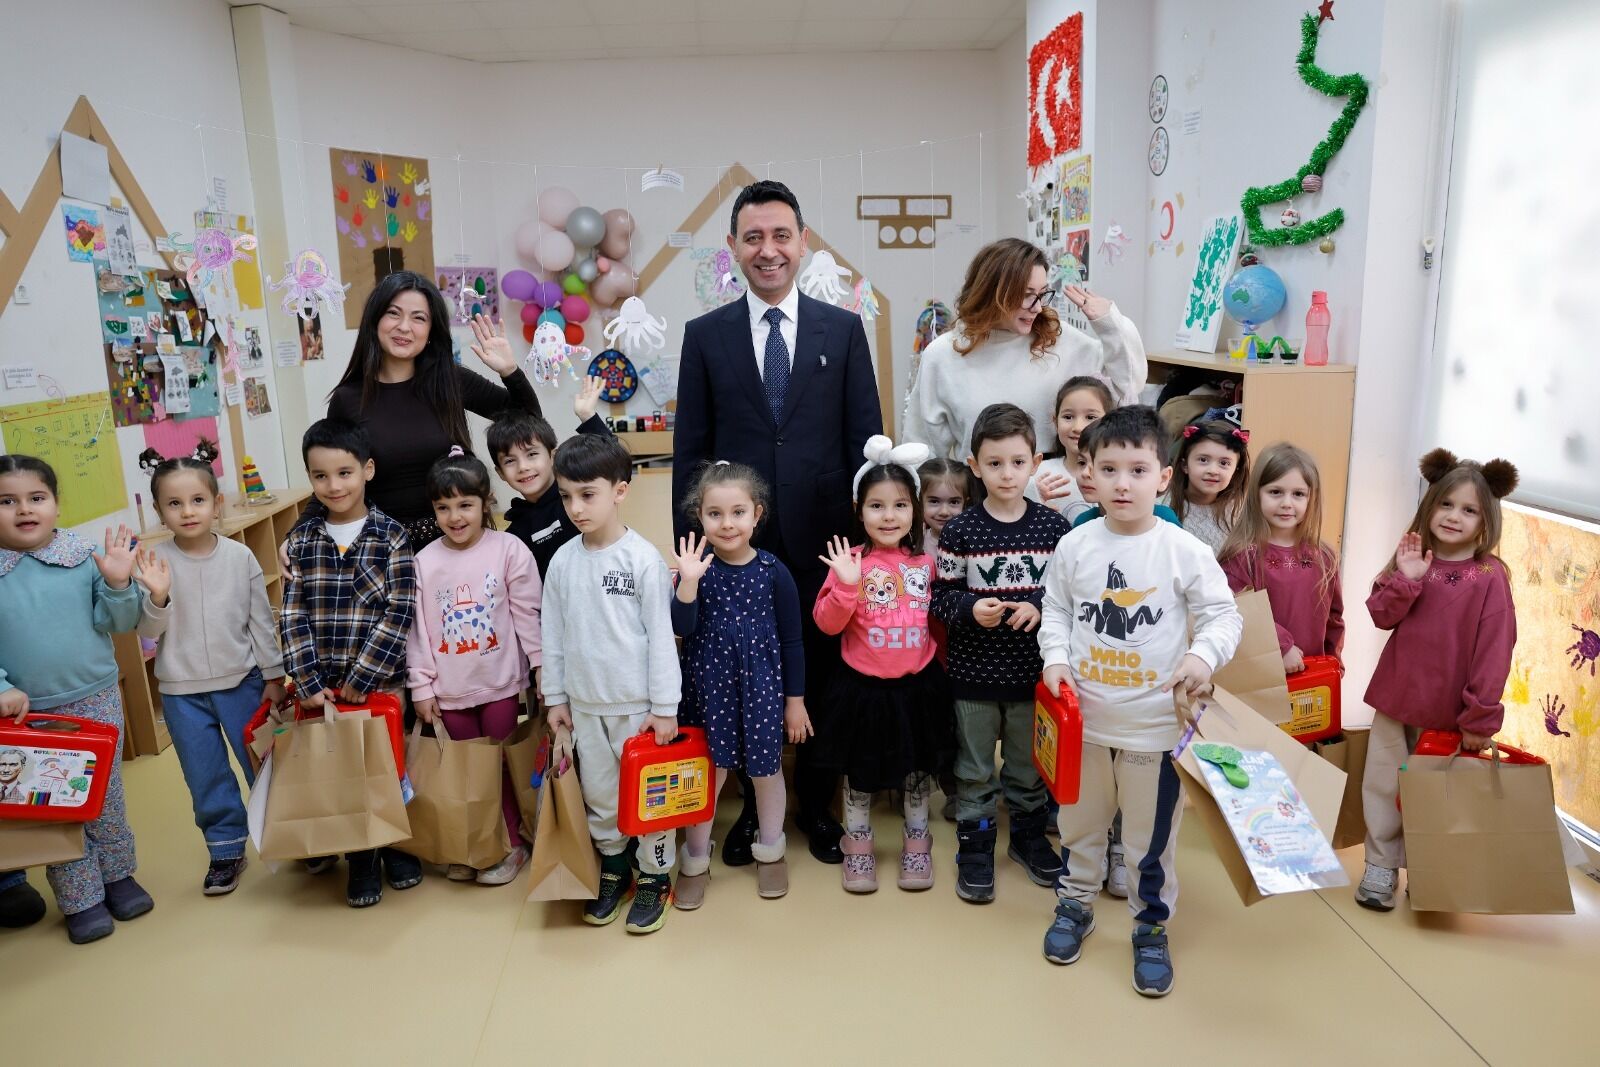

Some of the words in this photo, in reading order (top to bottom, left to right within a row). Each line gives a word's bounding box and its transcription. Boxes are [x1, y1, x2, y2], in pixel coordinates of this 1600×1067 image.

[602, 576, 619, 587] NEW
[868, 626, 928, 649] GIR
[1090, 645, 1141, 669] WHO
[1079, 660, 1157, 689] CARES?
[654, 843, 667, 868] RISE
